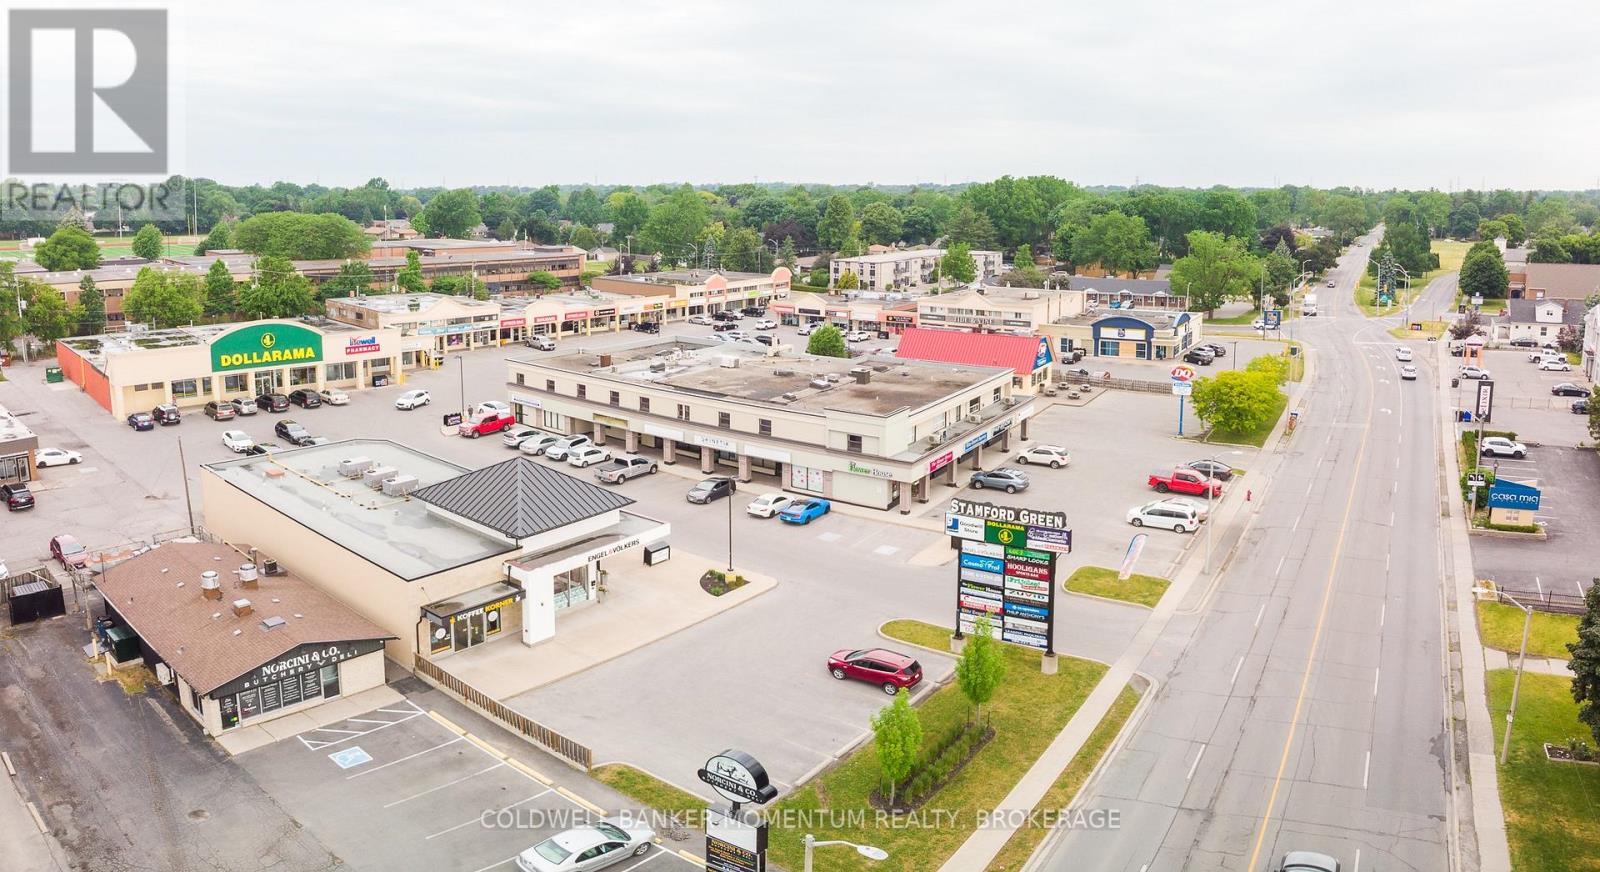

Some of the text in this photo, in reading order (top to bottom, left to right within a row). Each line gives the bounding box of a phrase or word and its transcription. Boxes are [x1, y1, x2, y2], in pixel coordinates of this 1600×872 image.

[220, 347, 316, 367] DOLLARAMA
[347, 345, 379, 353] PHARMACY
[1491, 493, 1539, 503] casa mia
[951, 499, 1063, 528] STAMFORD GREEN
[986, 520, 1025, 531] DOLLARAMA
[1007, 562, 1048, 575] HOOLIGANS
[457, 597, 514, 622] KOFFEE KORNER
[244, 663, 312, 688] BUTCHERY
[331, 649, 358, 662] DELI
[261, 646, 341, 676] NORCINI & CO.
[706, 773, 758, 798] NORCINI & CO.
